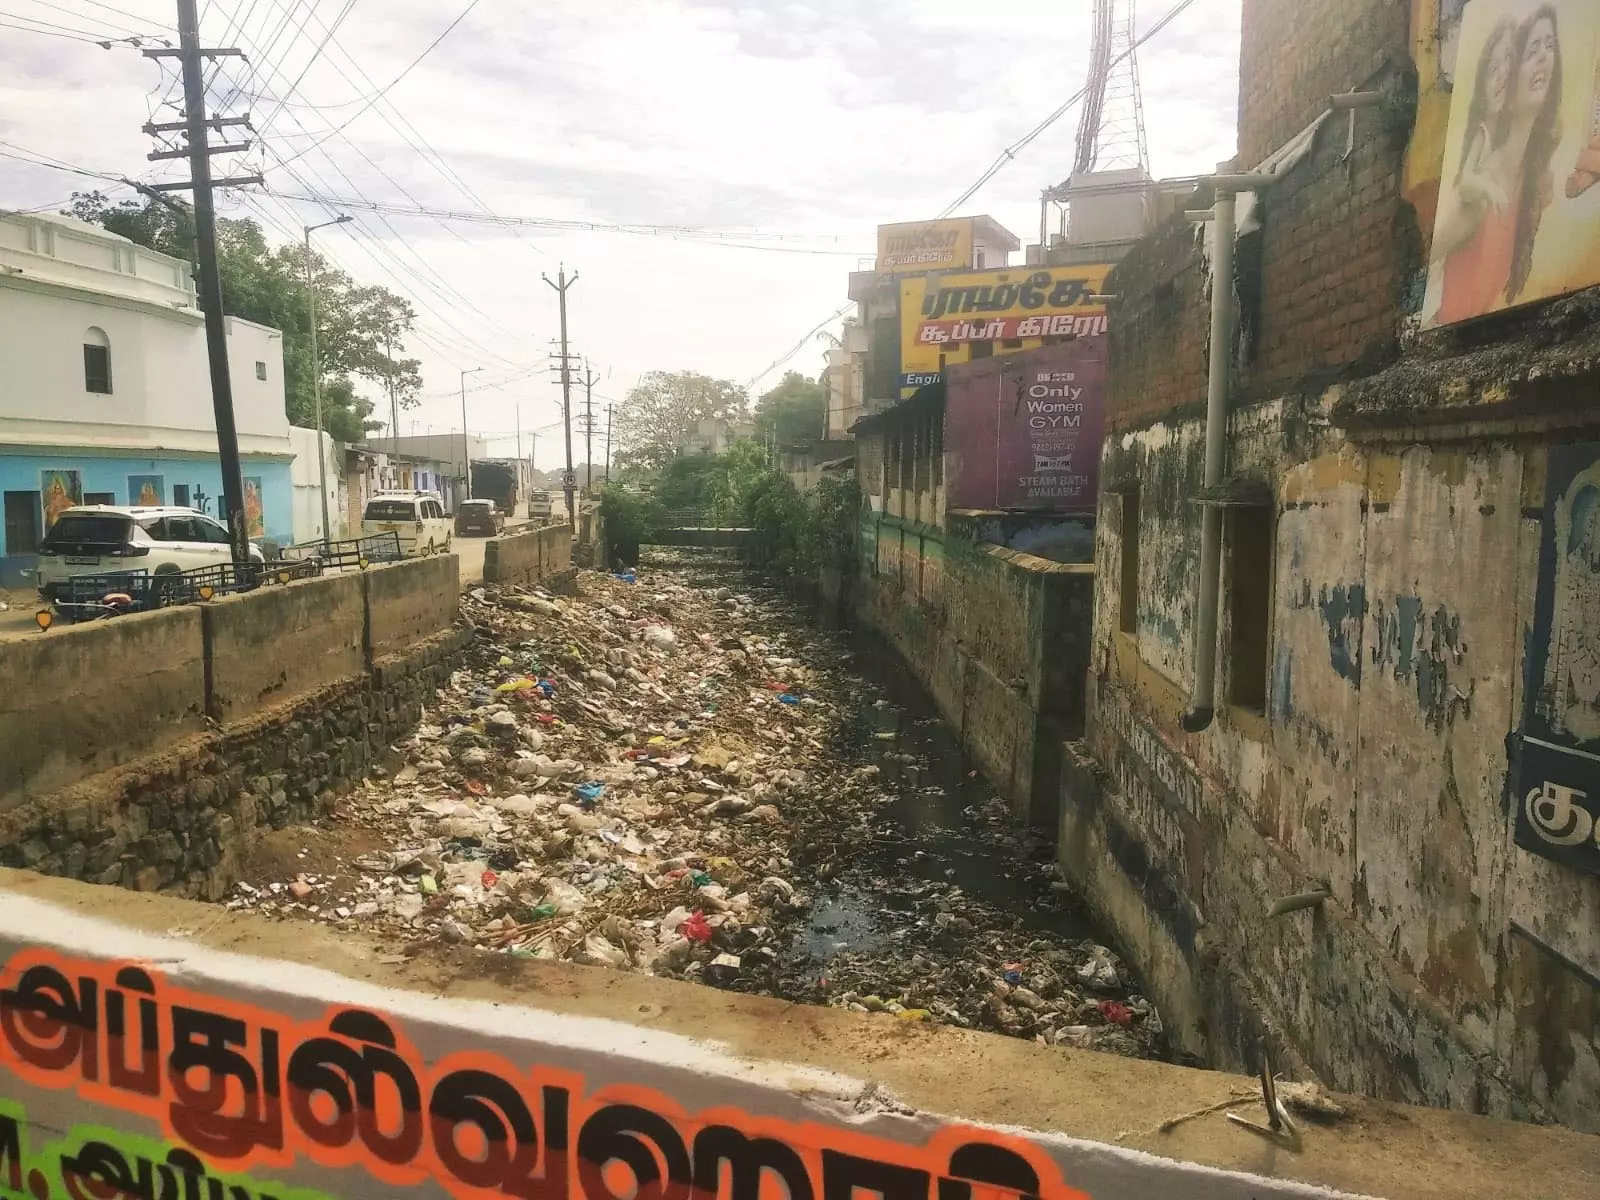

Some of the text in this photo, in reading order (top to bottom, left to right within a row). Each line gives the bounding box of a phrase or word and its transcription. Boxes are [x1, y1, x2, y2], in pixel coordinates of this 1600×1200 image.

[906, 373, 940, 386] Engi
[1029, 384, 1082, 400] Only
[1027, 400, 1083, 413] Women
[1029, 415, 1081, 428] GYM
[1019, 475, 1088, 487] STEAM BATH
[1027, 486, 1081, 497] AVAILABLE
